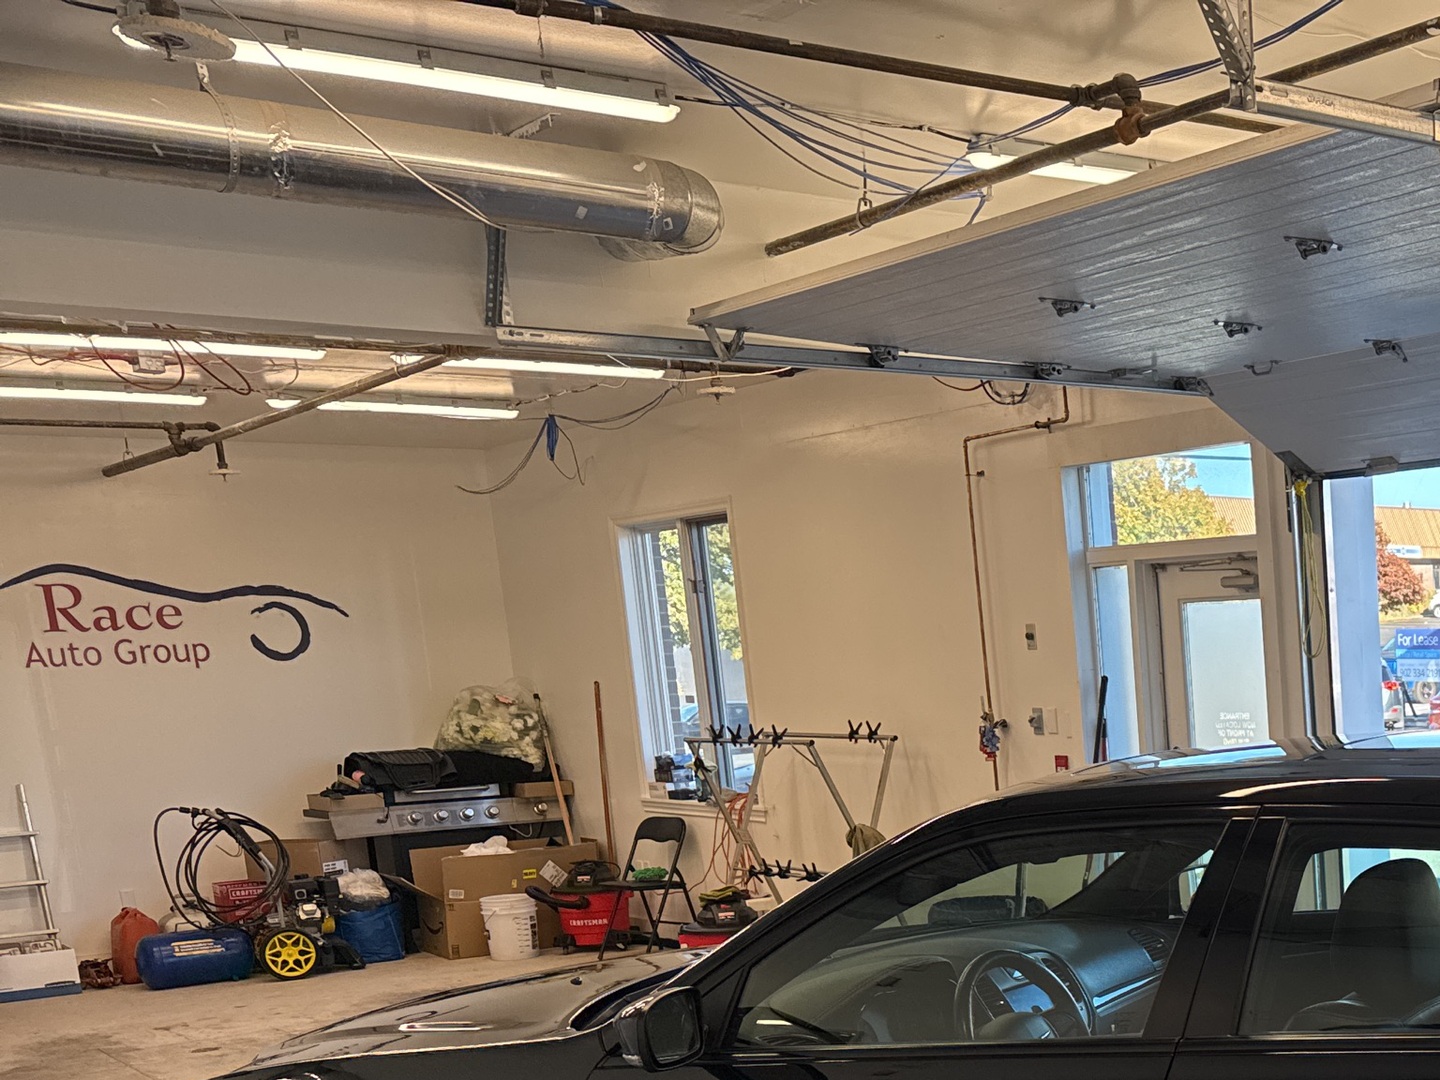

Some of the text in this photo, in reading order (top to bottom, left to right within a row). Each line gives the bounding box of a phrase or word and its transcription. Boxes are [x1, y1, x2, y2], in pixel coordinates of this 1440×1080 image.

[34, 583, 184, 633] Race
[1397, 634, 1412, 646] For
[1413, 634, 1439, 646] Lease
[25, 638, 211, 669] Auto Group
[231, 889, 263, 897] CRAFTSM
[569, 918, 609, 926] CRAFTSMAN
